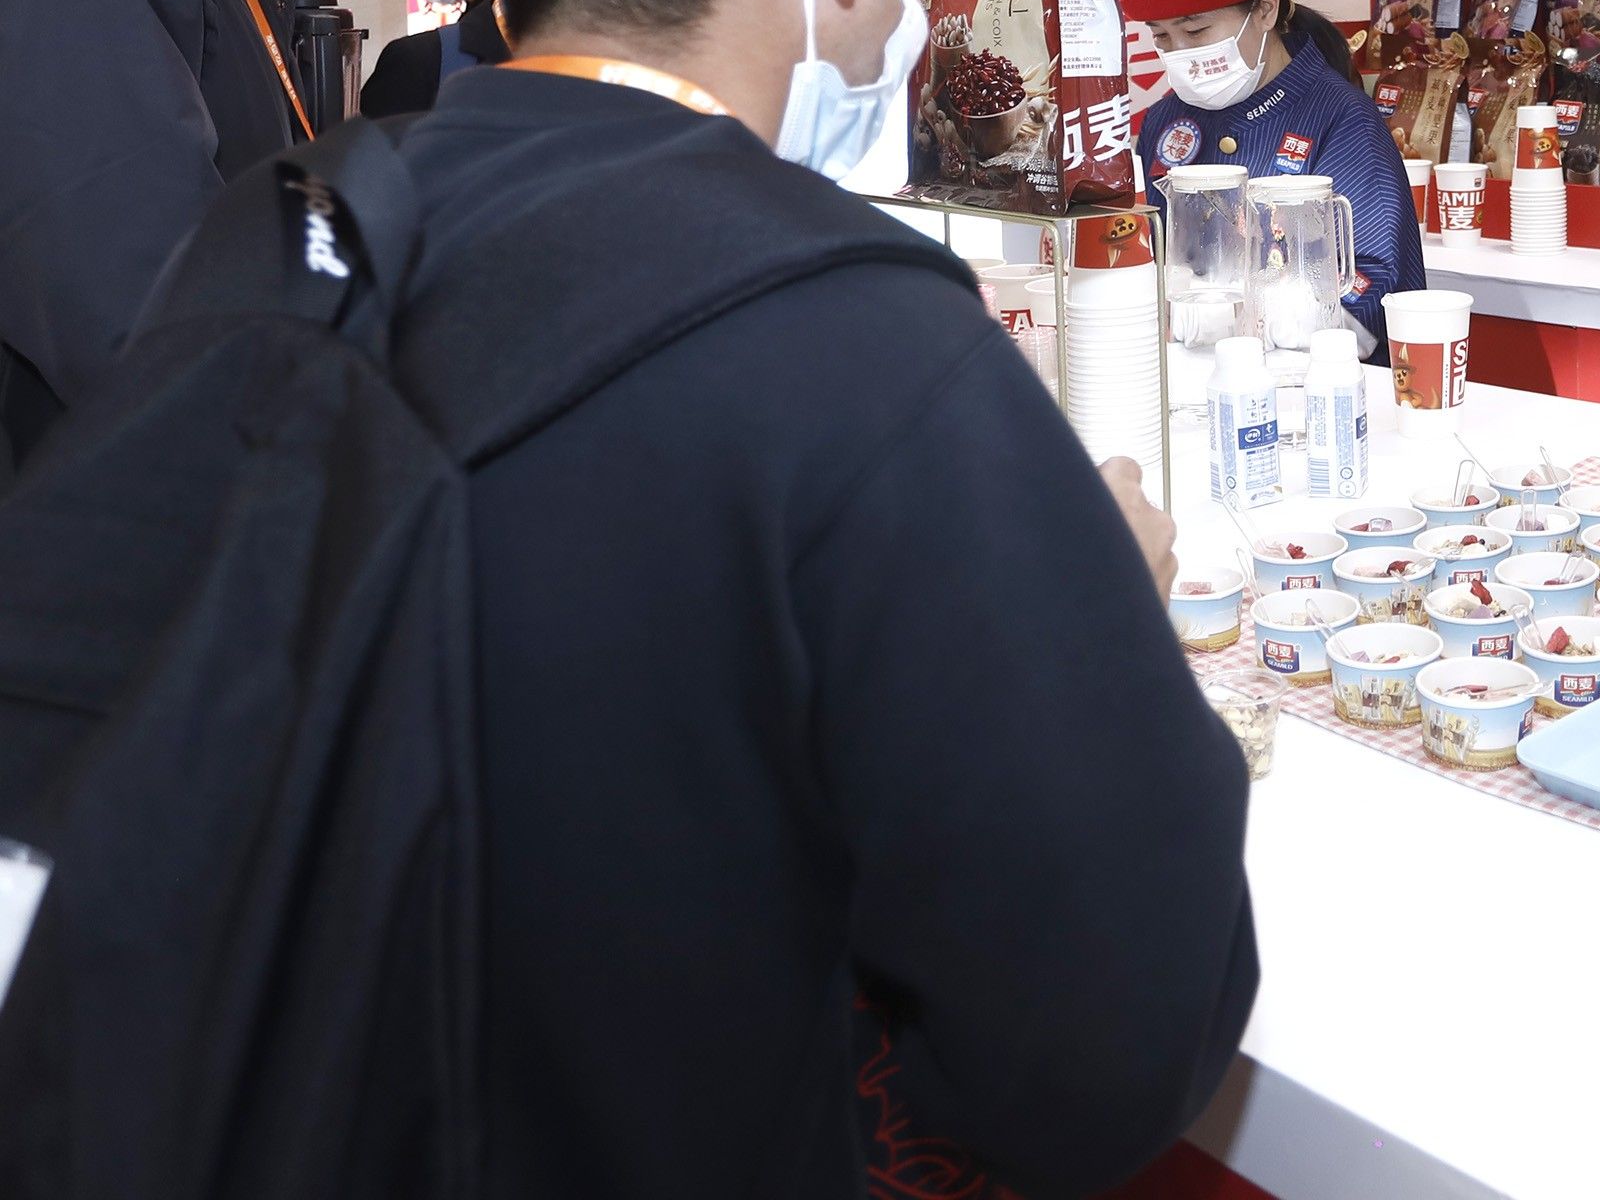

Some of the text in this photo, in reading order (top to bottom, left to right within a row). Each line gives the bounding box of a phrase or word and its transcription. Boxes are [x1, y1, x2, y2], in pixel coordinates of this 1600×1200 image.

[993, 18, 1002, 47] COIX
[1247, 89, 1285, 121] SEAMILD
[1169, 127, 1195, 146] 燕麦
[1283, 136, 1309, 155] 西麦
[1276, 157, 1301, 171] SEAMILD
[1267, 643, 1292, 659] 西麦
[1563, 676, 1592, 691] 西麦
